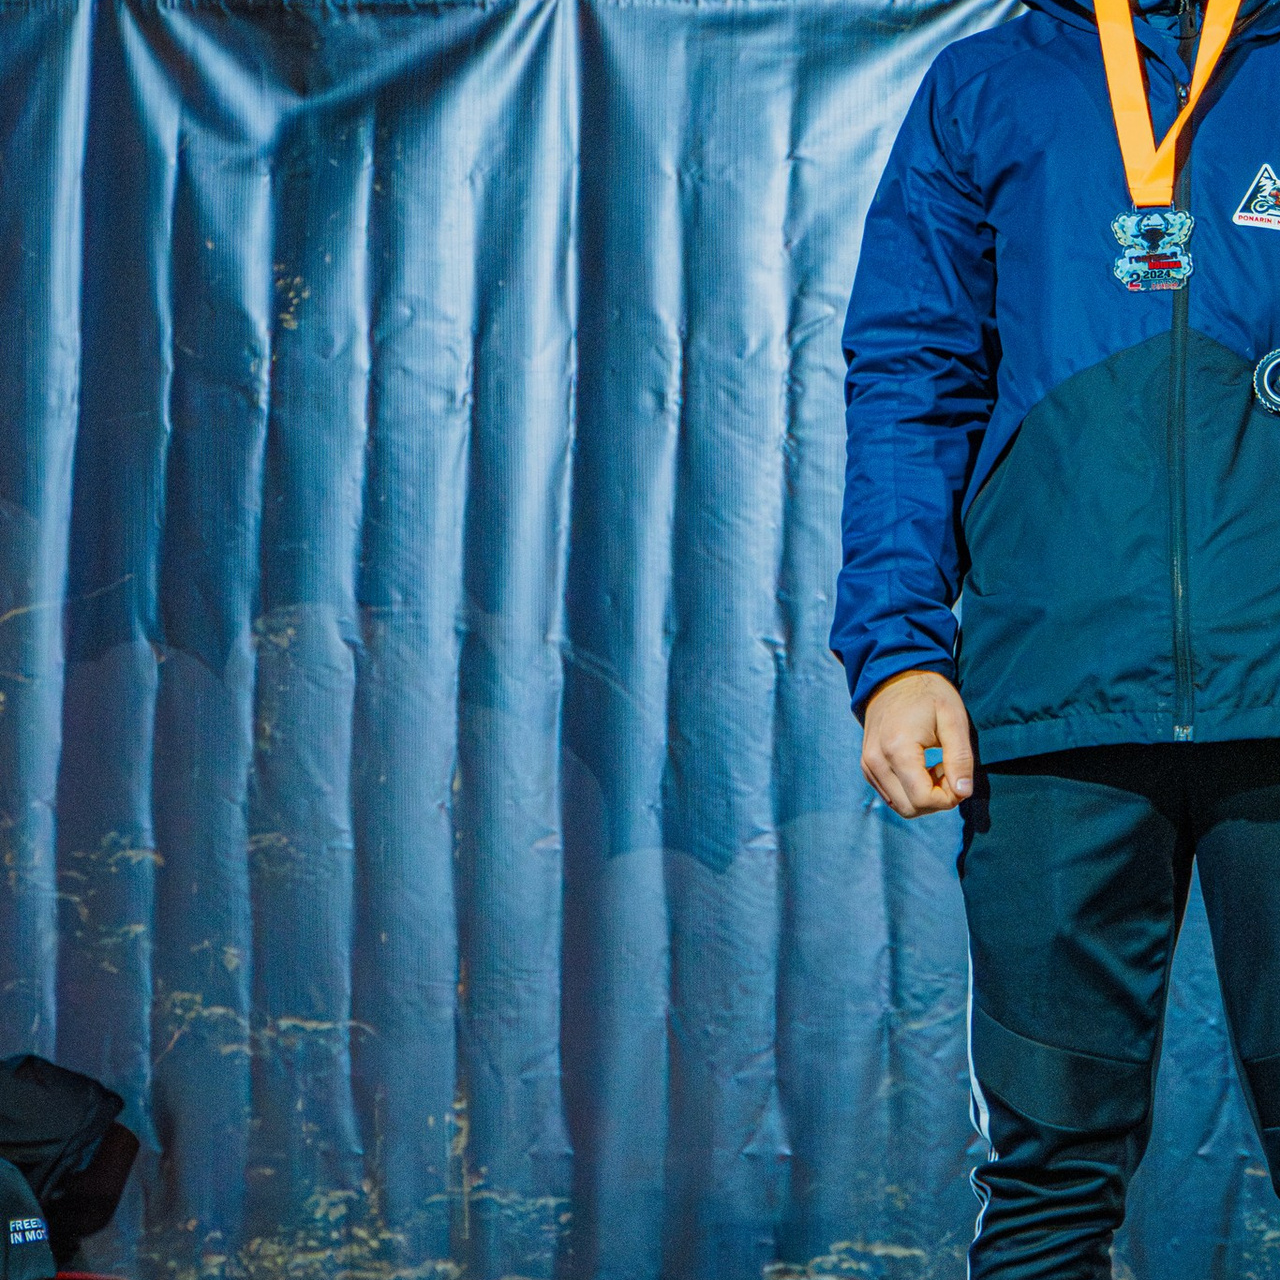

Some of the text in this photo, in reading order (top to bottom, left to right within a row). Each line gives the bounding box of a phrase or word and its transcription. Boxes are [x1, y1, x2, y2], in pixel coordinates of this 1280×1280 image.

[1238, 214, 1272, 224] PONARIN
[1143, 270, 1171, 279] 2024
[1128, 272, 1142, 289] 2
[10, 1231, 23, 1244] IN
